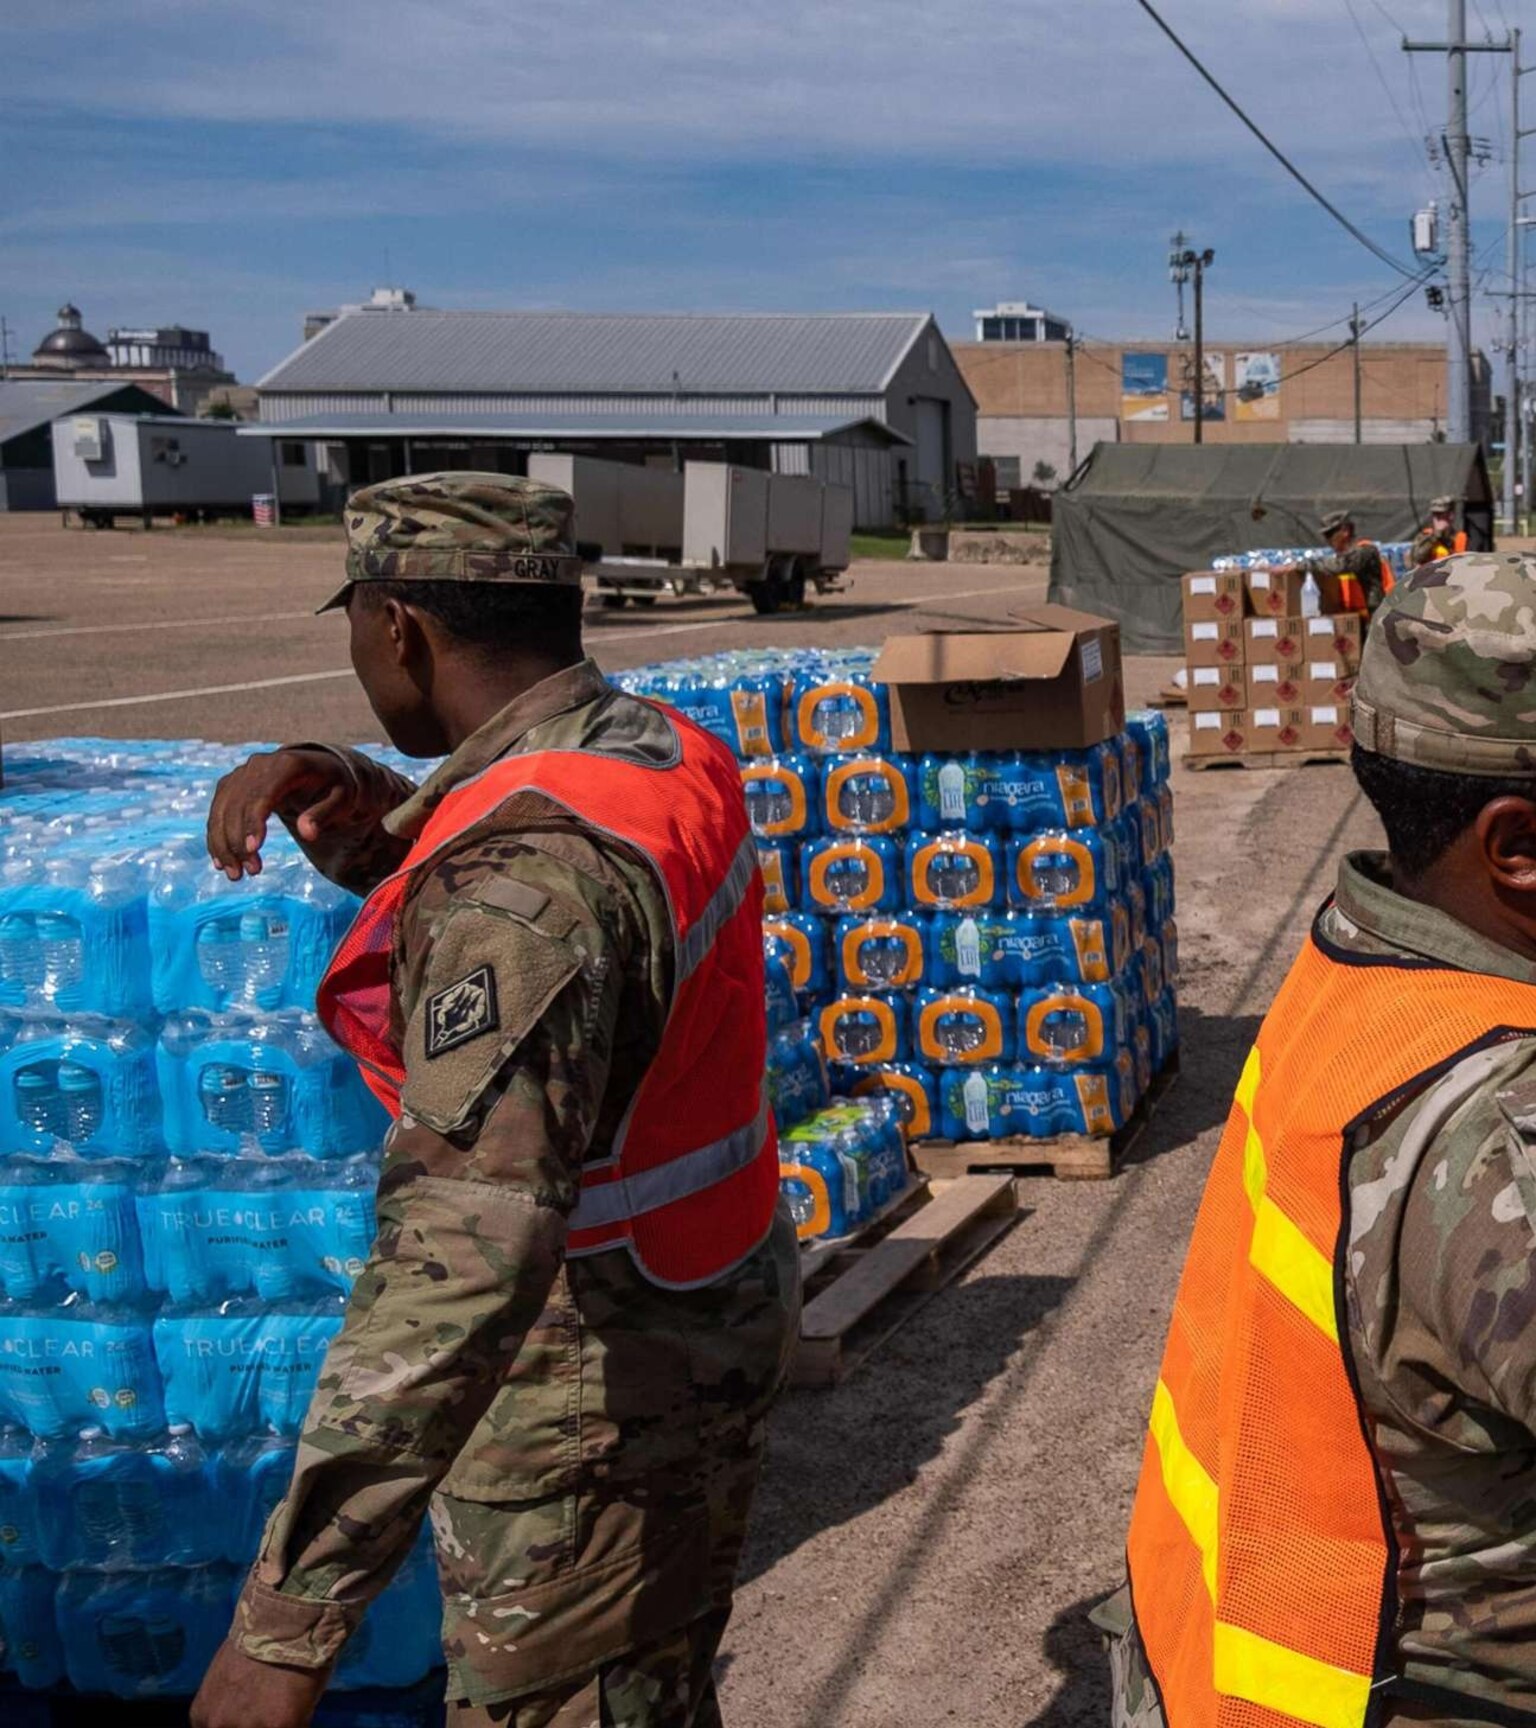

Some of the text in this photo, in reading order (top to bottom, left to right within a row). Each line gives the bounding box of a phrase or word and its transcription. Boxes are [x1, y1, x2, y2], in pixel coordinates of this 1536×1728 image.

[514, 559, 560, 578] GRAY
[983, 780, 1045, 796] niagara
[998, 933, 1060, 950] niagara
[1005, 1088, 1064, 1107] niagara
[13, 1338, 94, 1358] CLEAR
